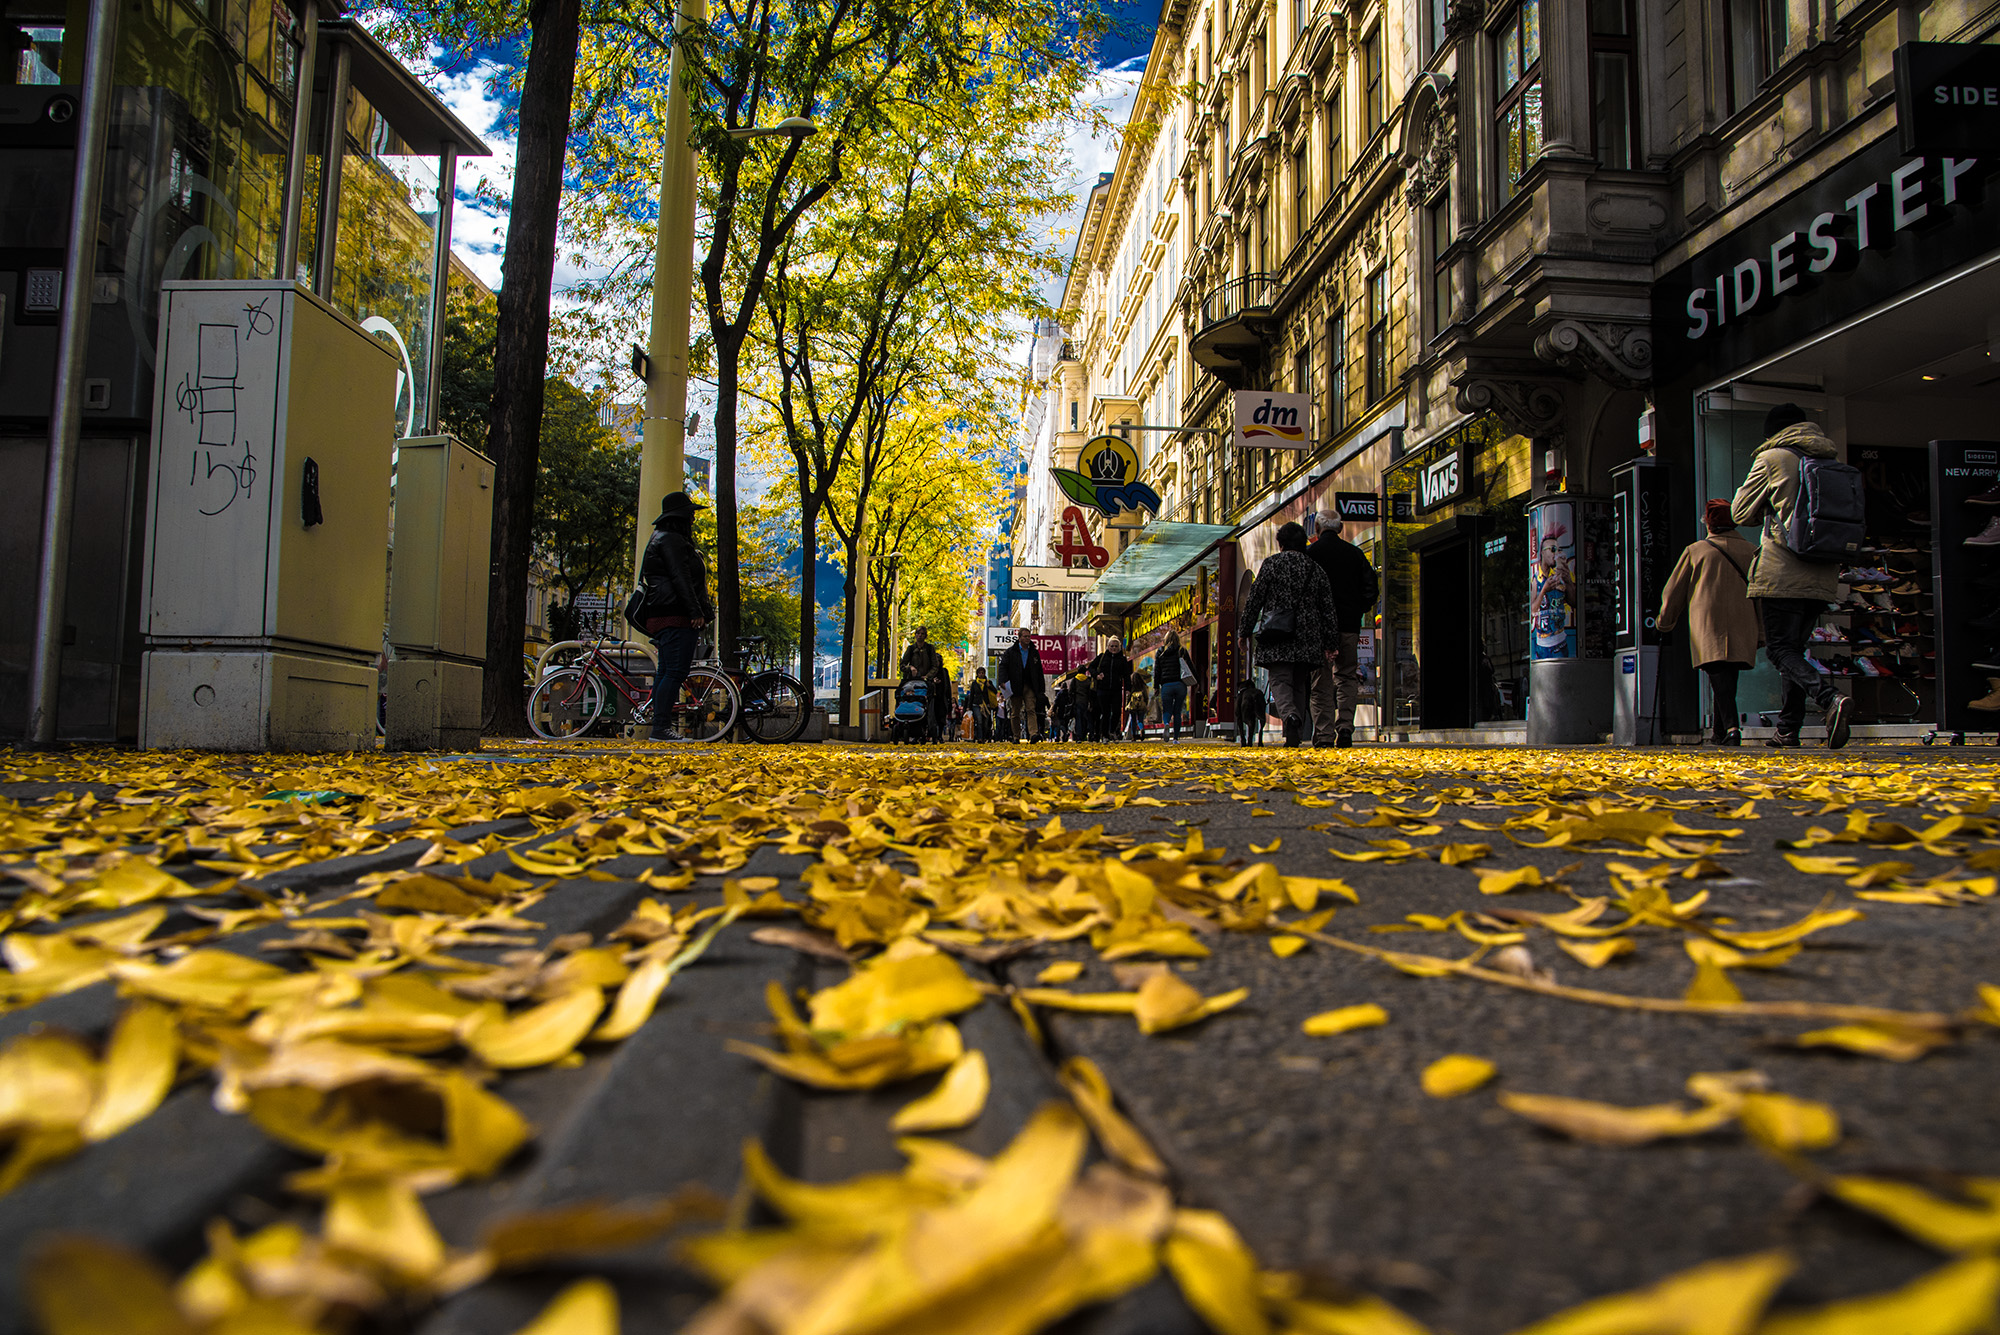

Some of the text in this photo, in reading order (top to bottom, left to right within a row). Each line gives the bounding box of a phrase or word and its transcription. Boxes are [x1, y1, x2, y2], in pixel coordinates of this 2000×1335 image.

[1687, 156, 1977, 339] SIDESTEP
[1252, 399, 1298, 426] dm
[1420, 451, 1459, 507] VANS
[1945, 468, 1970, 476] NEW
[1339, 500, 1376, 515] VANS
